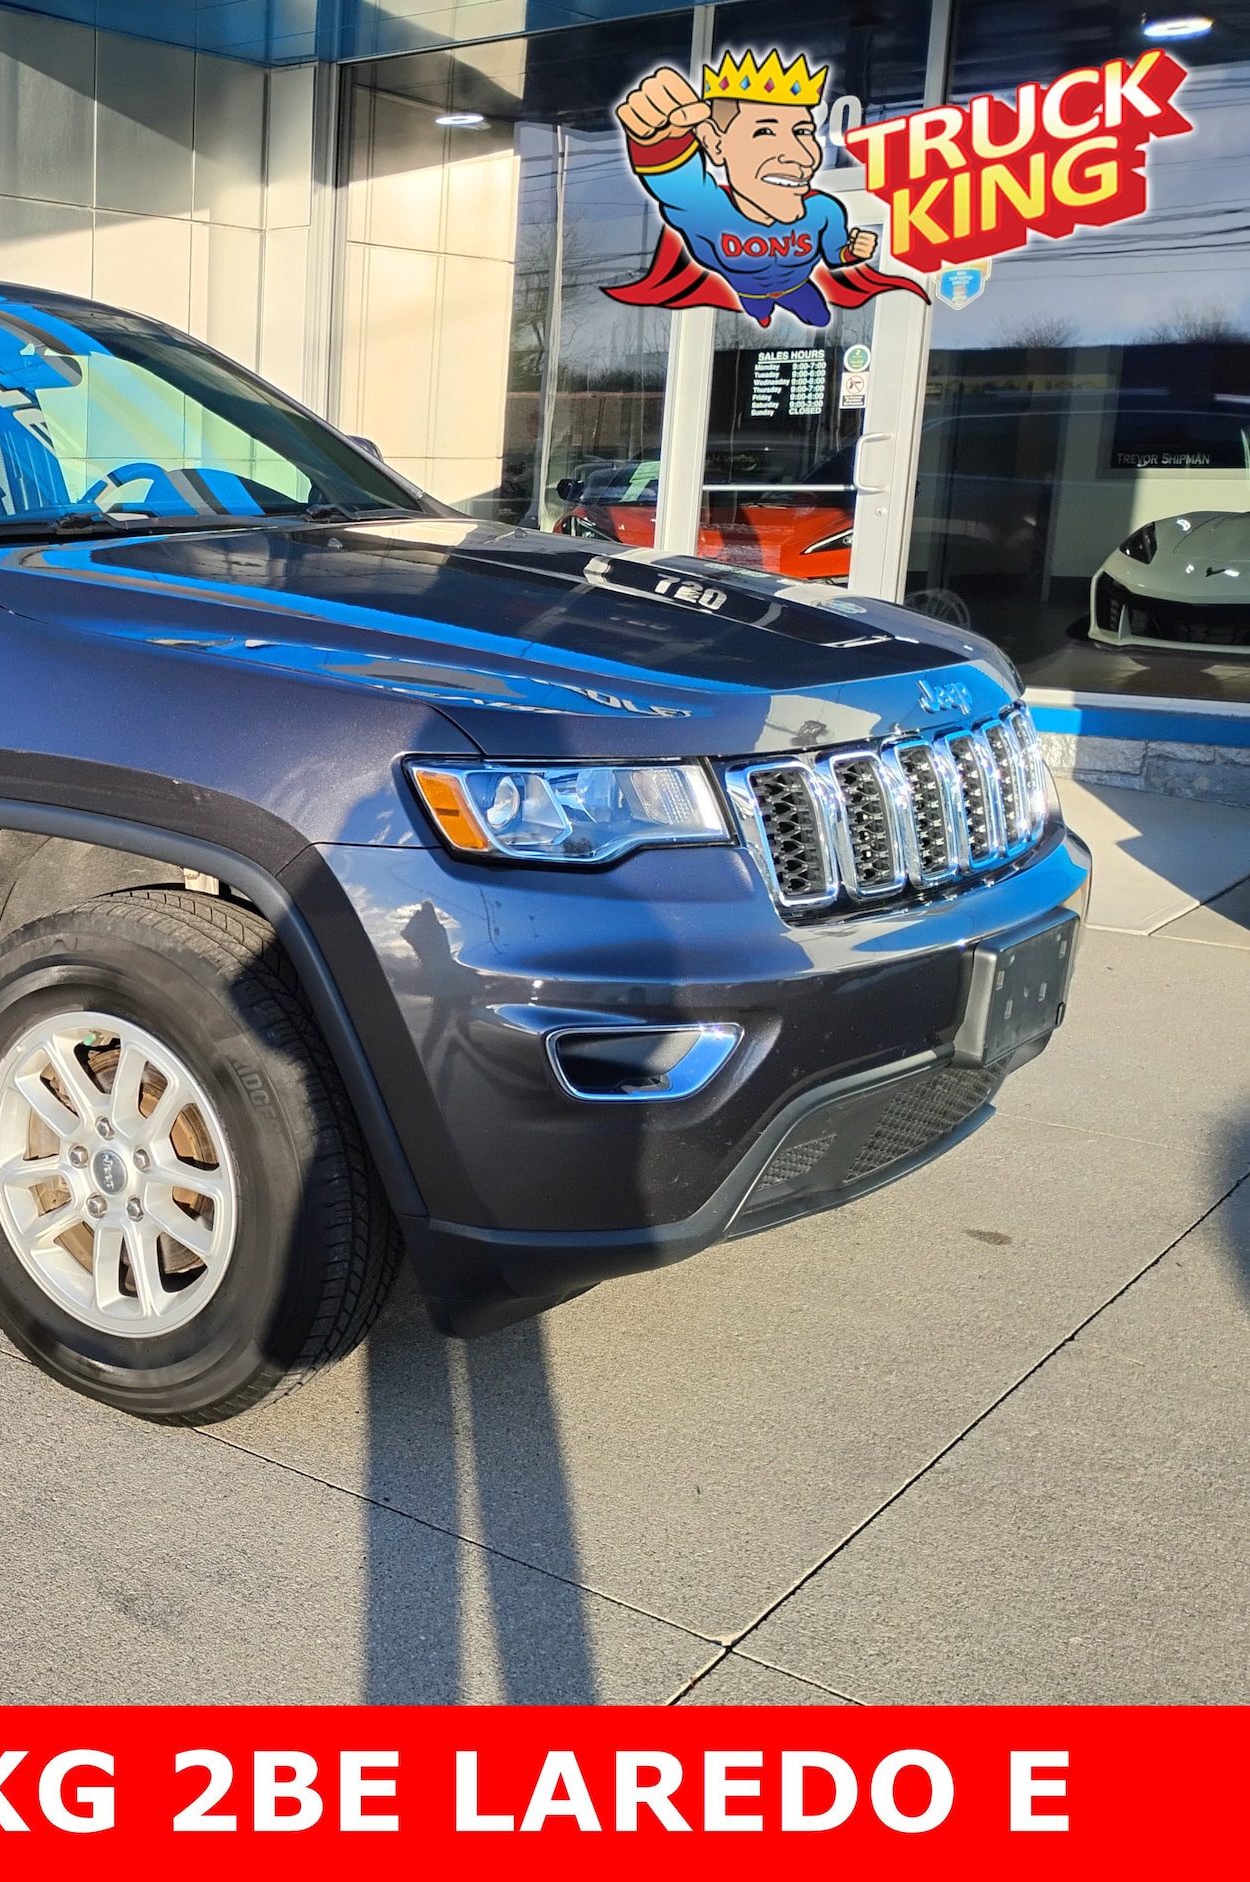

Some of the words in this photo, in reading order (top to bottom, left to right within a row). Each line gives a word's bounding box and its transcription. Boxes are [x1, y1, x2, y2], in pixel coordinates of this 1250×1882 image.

[758, 352, 790, 361] SALES
[791, 350, 825, 359] HOURS
[788, 407, 822, 415] CLOSED
[1116, 453, 1159, 468] TREVOR
[1161, 453, 1210, 465] SHIPMAN
[917, 679, 973, 715] Jeep
